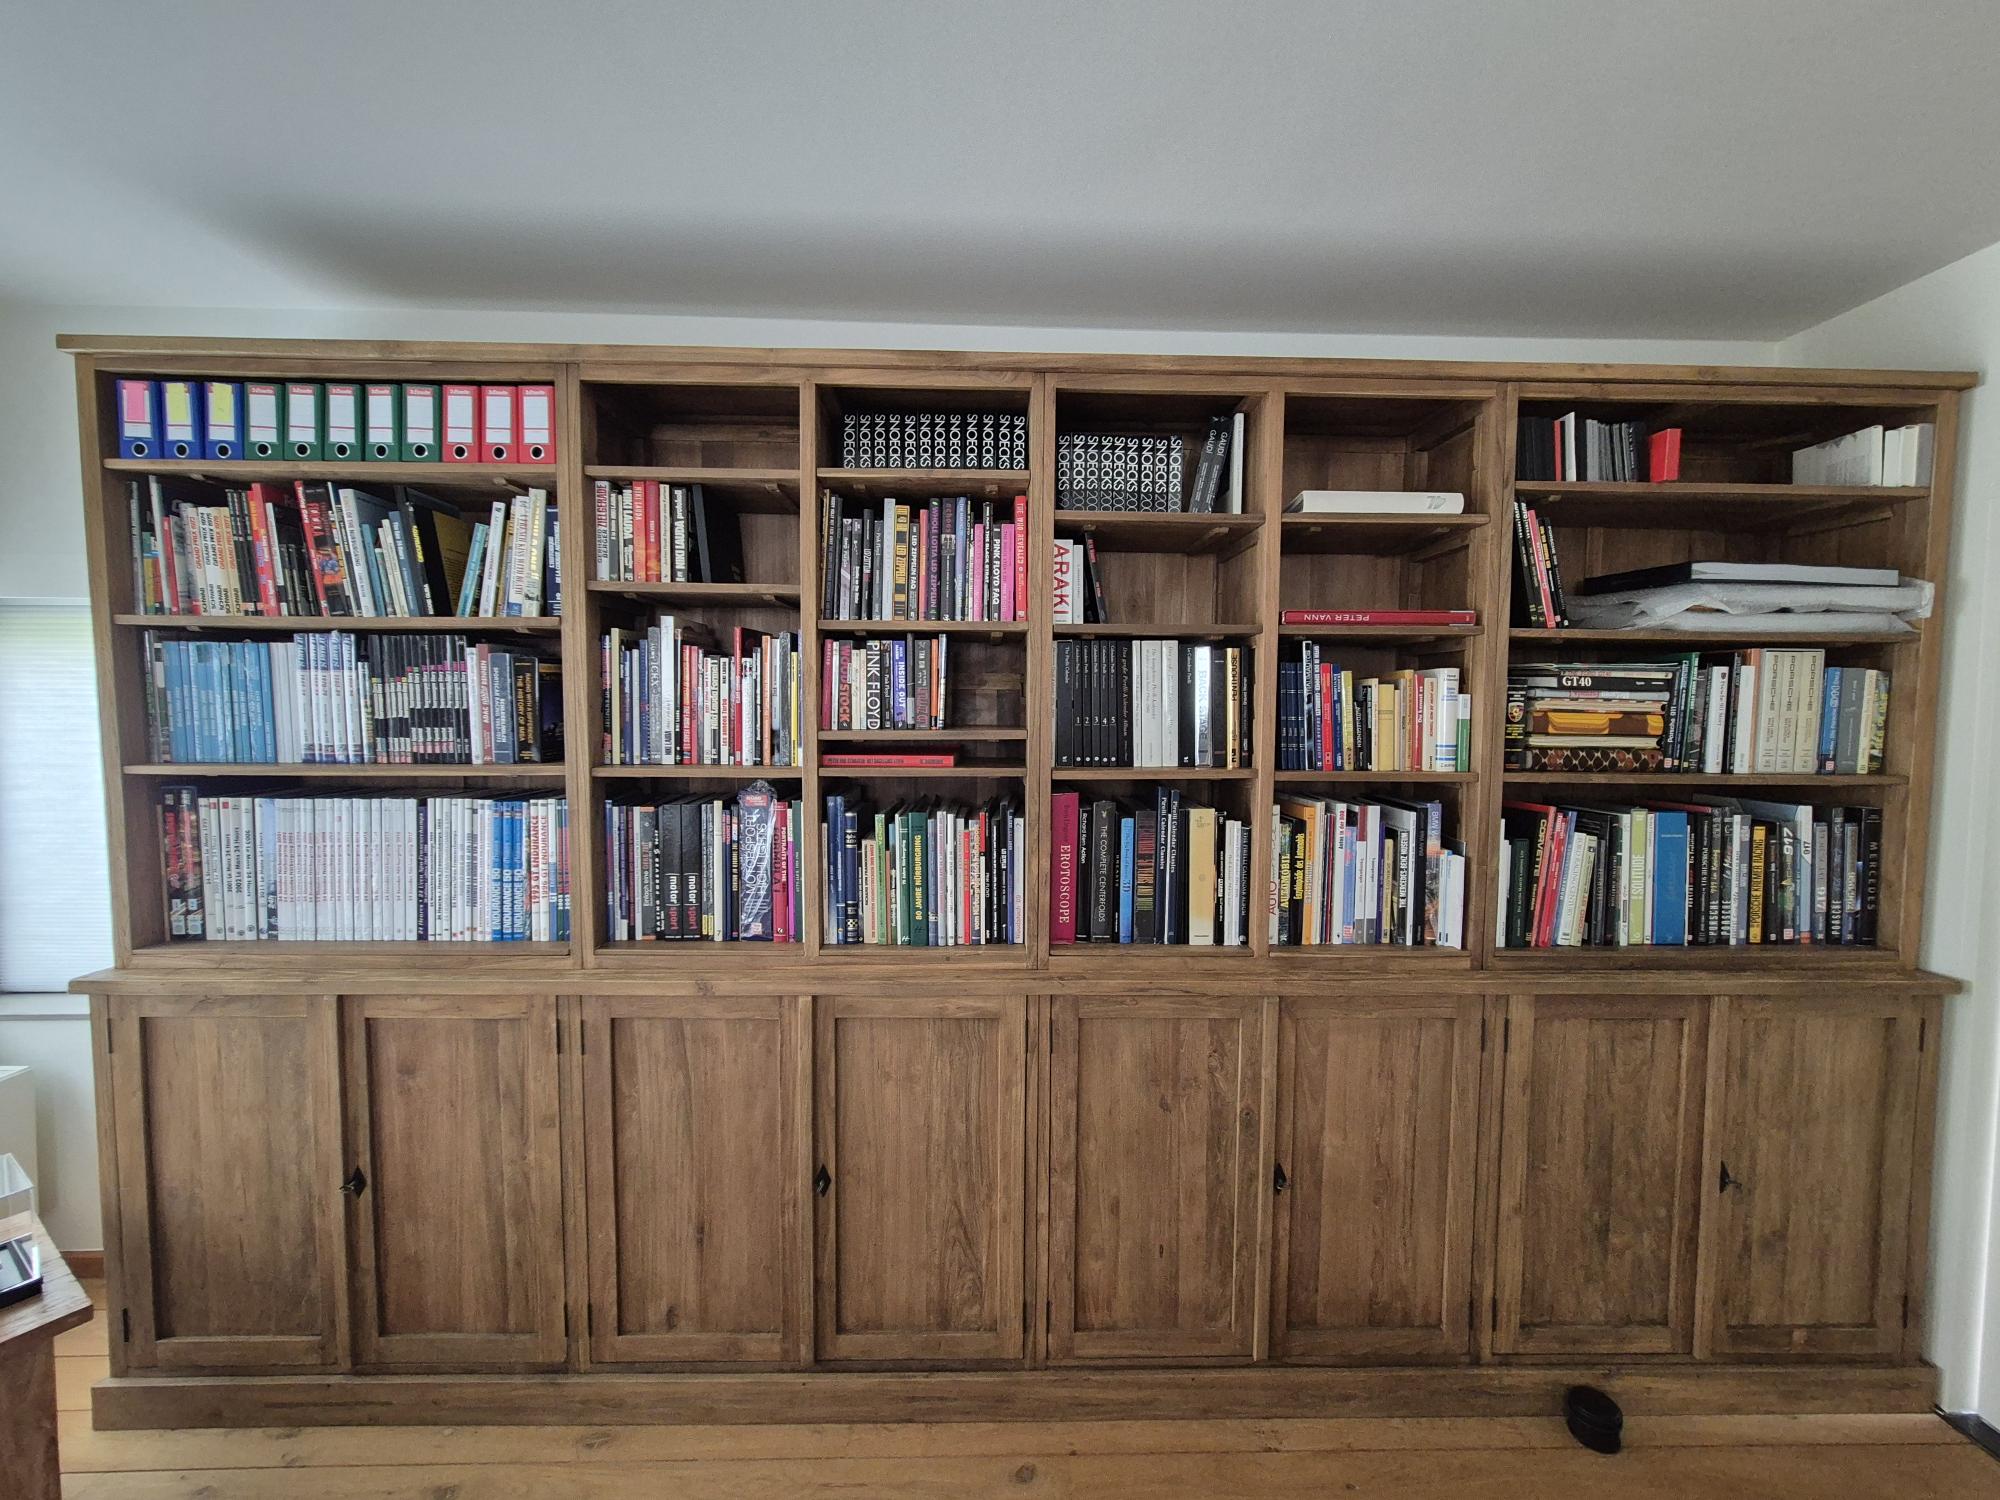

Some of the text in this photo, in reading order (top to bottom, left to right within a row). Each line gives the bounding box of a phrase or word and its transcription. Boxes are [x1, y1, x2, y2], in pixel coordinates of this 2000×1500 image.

[844, 415, 855, 469] SNOECKS
[860, 415, 871, 468] SNOECKS
[875, 415, 885, 467] SNOECKS
[890, 414, 900, 467] SNOECKS
[905, 415, 916, 468] SNOECKS
[920, 414, 931, 467] SNOECKS
[935, 415, 945, 467] SNOECKS
[950, 415, 961, 467] SNOECKS
[967, 414, 978, 467] SNOECKS
[983, 415, 993, 467] SNOECKS
[999, 415, 1010, 469] SNOECKS
[1014, 416, 1025, 469] SNOECKS
[1058, 436, 1070, 491] SNOECKS
[1074, 435, 1085, 490] SNOECKS
[1087, 435, 1098, 490] SNOECKS
[1101, 436, 1112, 491] SNOECKS
[1114, 437, 1125, 491] SNOECKS
[1127, 438, 1138, 492] SNOECKS
[1142, 438, 1153, 492] SNOECKS
[1156, 440, 1167, 493] SNOECKS
[1170, 439, 1182, 492] SNOECKS
[1206, 430, 1217, 454] GAUDI
[1218, 432, 1228, 456] GAUDI
[597, 485, 607, 528] ZIELGERADE
[623, 490, 632, 539] NIKI LAUDA
[194, 547, 202, 569] GRAND
[217, 547, 225, 569] GRAND
[675, 521, 685, 569] NIKI LAUDA
[896, 545, 906, 583] LED ZEPPELIN
[1054, 543, 1070, 614] ARAKI
[840, 645, 850, 722] WOODSTOCK
[867, 643, 880, 729] PINK FLOYD
[1199, 671, 1207, 701] BACK
[1562, 677, 1591, 686] GT40
[1770, 655, 1778, 711] PORSCHE
[1787, 655, 1796, 711] PORSCHE
[1808, 655, 1816, 711] PORSCHE
[1418, 714, 1422, 722] Du
[1668, 718, 1676, 742] Porsche
[746, 812, 767, 894] MOTORSPORT HIGHLIGHTS
[914, 835, 922, 885] NÜRBURGRING
[1295, 860, 1303, 868] des
[1534, 819, 1547, 876] CORVETTE
[1755, 840, 1763, 863] RACING
[1784, 828, 1793, 855] 917
[532, 871, 538, 881] GT
[541, 868, 547, 878] GT
[1060, 845, 1070, 923] EROTOSCOPE
[1280, 854, 1290, 907] AUTOMOBIL
[1400, 855, 1408, 896] MERCEDES-BENZ
[1632, 855, 1644, 894] SOLITUDE
[1868, 842, 1876, 910] MERCEDES
[492, 882, 500, 930] ENDURANCE
[503, 883, 511, 932] ENDURANCE
[514, 883, 522, 932] ENDURANCE
[669, 907, 678, 929] sport
[688, 907, 697, 929] sport
[1709, 901, 1718, 935] PORSCHE
[1721, 901, 1731, 935] PORSCHE
[1753, 894, 1761, 924] PORSCHE
[1832, 900, 1840, 934] PORSCHE
